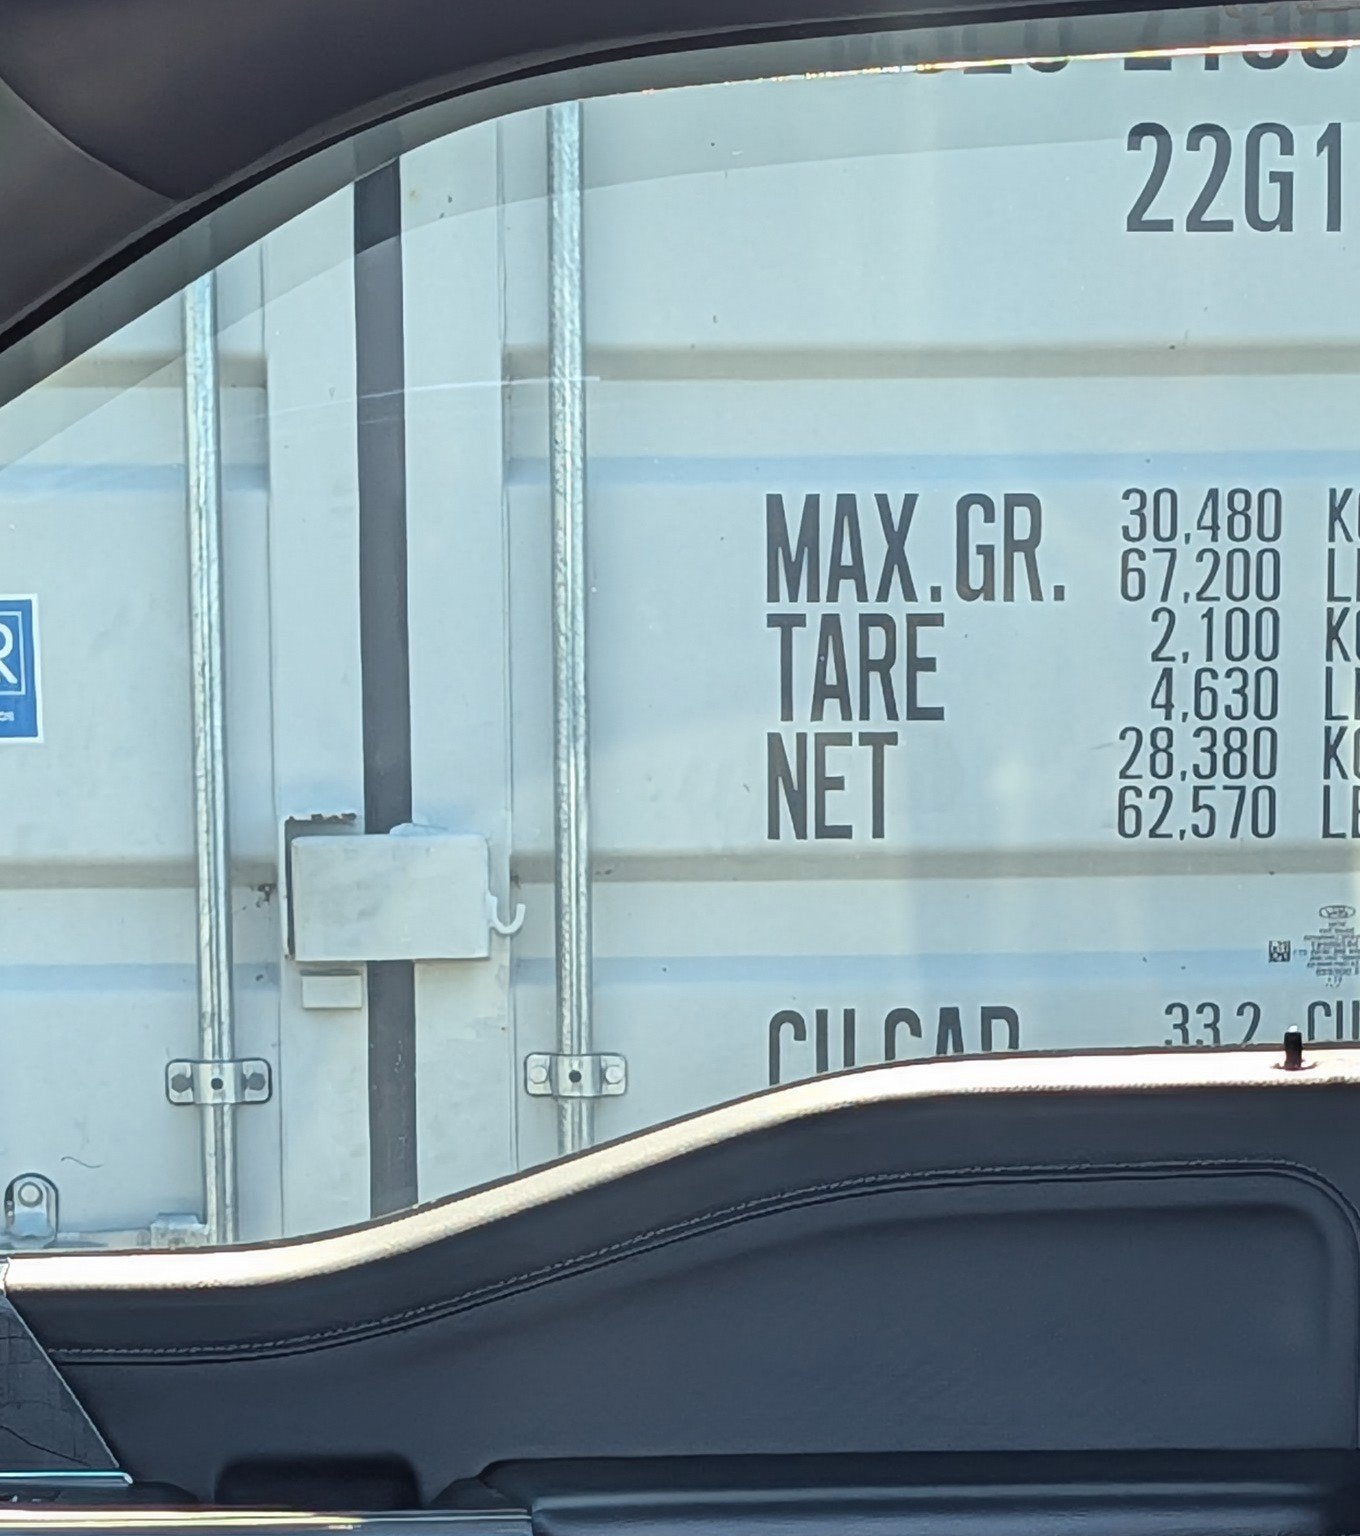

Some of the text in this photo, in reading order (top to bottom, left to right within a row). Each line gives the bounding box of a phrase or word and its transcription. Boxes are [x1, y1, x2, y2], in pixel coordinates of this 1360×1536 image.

[1126, 122, 1343, 232] 22G1
[766, 493, 1065, 602] MAX.GR.
[1121, 488, 1282, 545] 30,480
[1120, 547, 1281, 604] 67,200
[766, 612, 945, 722] TARE
[1150, 607, 1280, 663] 2,100
[1150, 666, 1279, 723] 4,630
[767, 731, 899, 841] NET
[1118, 725, 1278, 782] 28,380
[1117, 784, 1277, 841] 62,570
